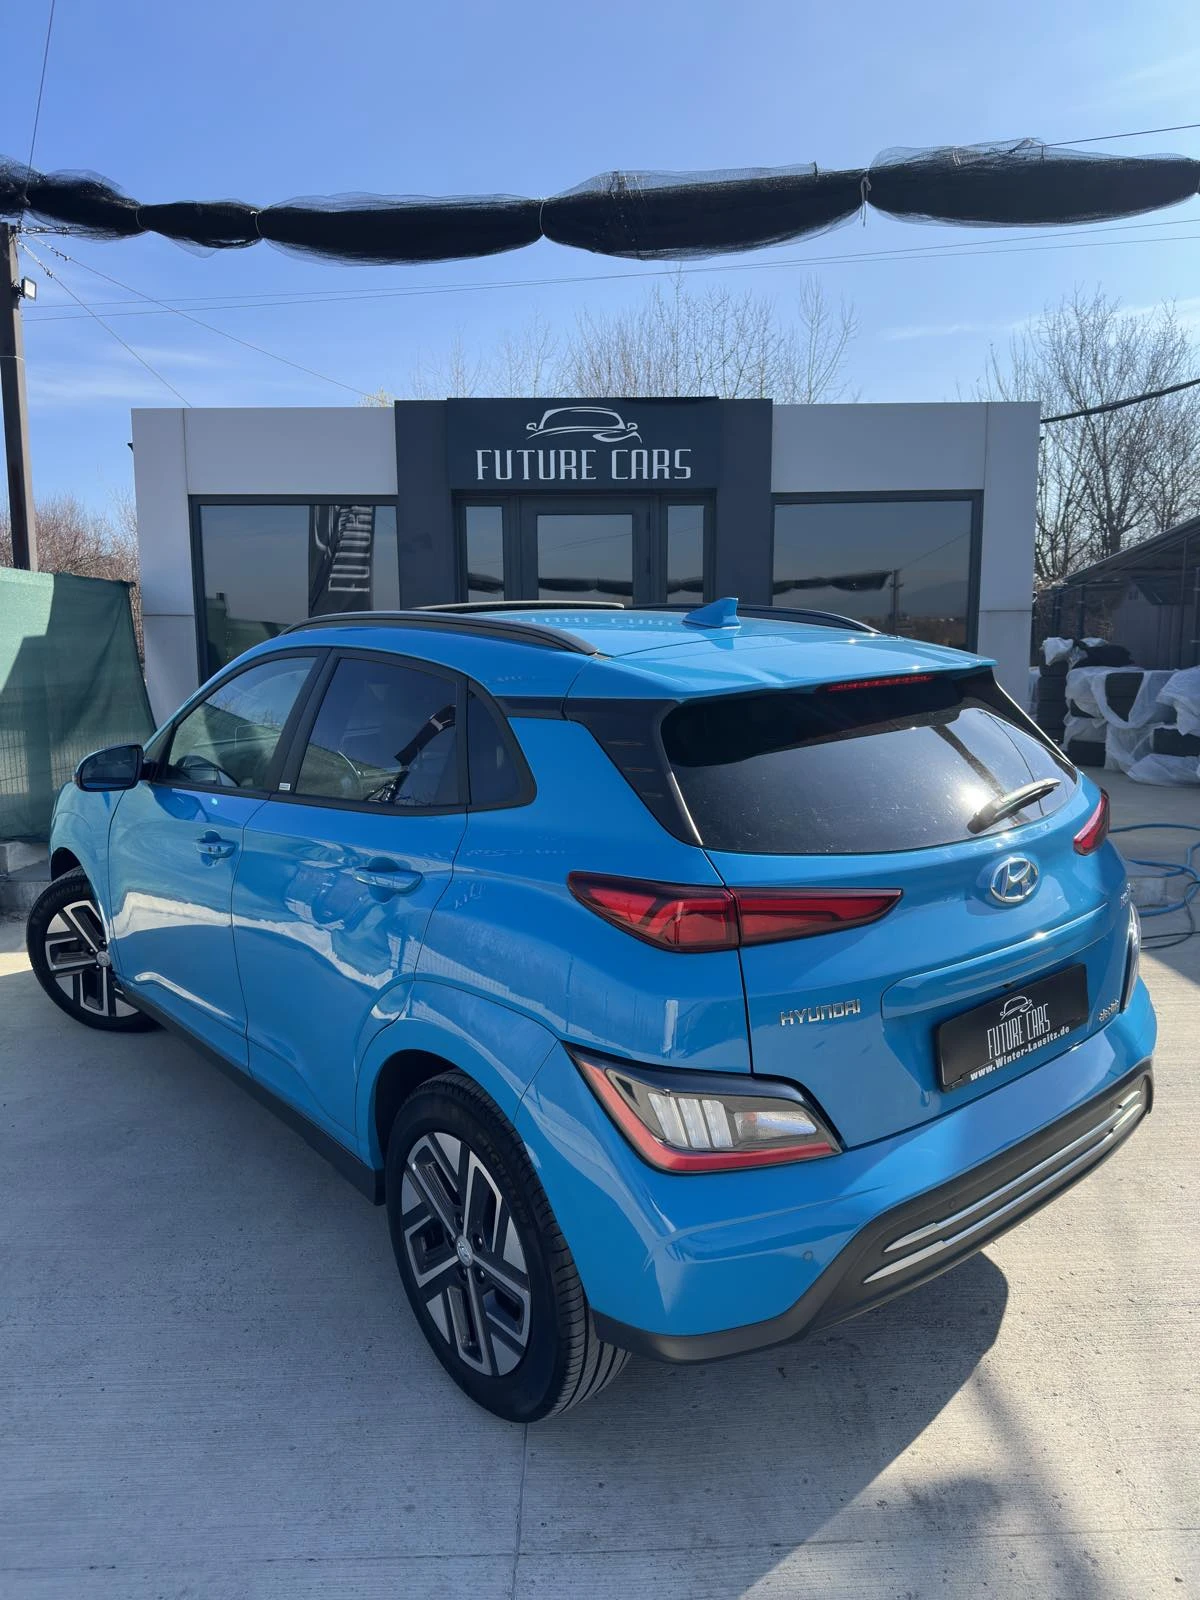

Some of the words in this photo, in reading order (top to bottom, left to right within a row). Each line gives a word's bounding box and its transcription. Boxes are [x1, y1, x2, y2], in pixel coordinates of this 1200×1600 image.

[476, 449, 597, 480] FUTURE
[611, 449, 692, 480] CARS
[780, 999, 861, 1026] HYUNDAI
[987, 1015, 1025, 1060] FUTURE
[1026, 1003, 1051, 1040] CARS
[970, 1026, 1070, 1081] www.Winter-Lausitz.de
